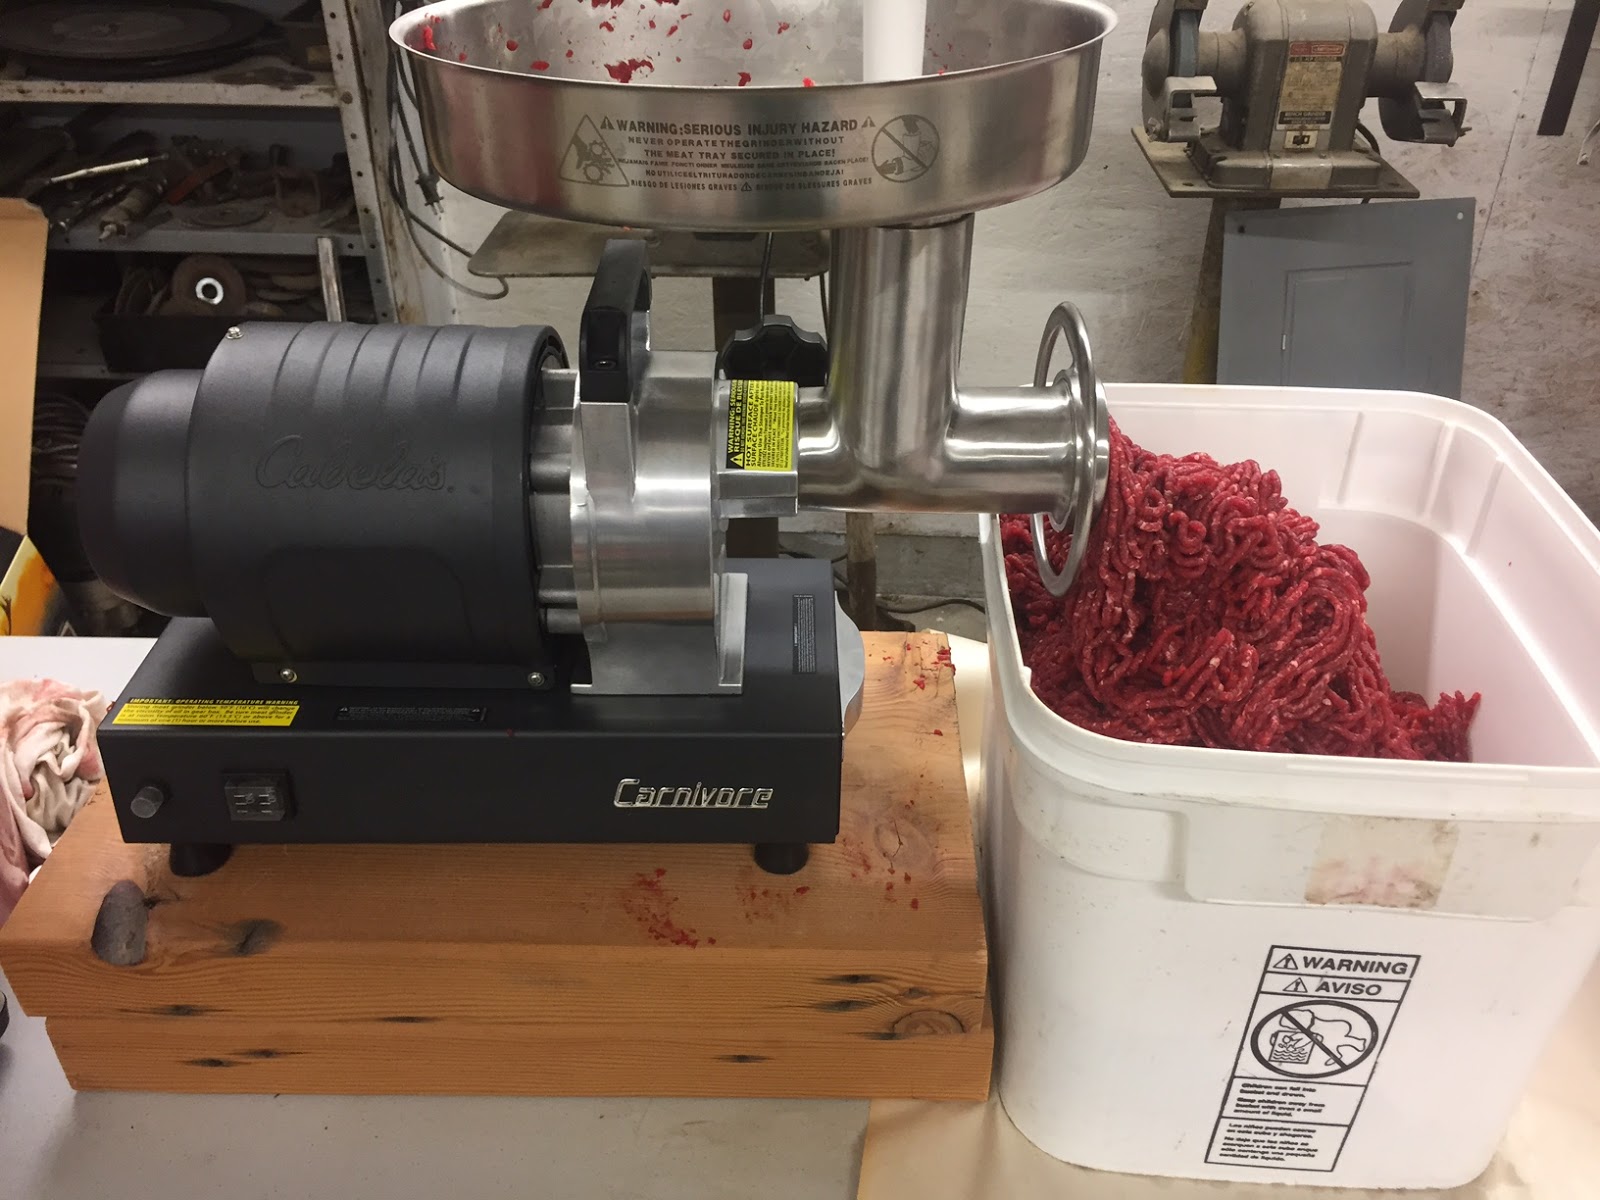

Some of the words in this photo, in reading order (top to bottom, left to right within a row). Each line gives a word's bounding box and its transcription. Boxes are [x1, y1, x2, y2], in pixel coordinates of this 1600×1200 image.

[747, 122, 797, 136] INJURY
[801, 119, 858, 133] HAZARD
[628, 136, 664, 146] NEVER
[644, 149, 666, 158] THE
[666, 150, 694, 159] MEAT
[698, 151, 726, 160] TRAY
[730, 151, 779, 160] SECURED
[783, 151, 795, 159] IN
[798, 149, 836, 158] PLACE!
[631, 179, 657, 188] RIESGO
[659, 181, 668, 189] DE
[671, 181, 706, 191] LESIONES
[708, 182, 737, 191] GRAVES
[843, 177, 872, 187] GRAVES
[735, 401, 742, 413] DE
[746, 401, 754, 443] SURFACE
[734, 415, 742, 453] RISQUE
[613, 778, 774, 809] Carnivore
[1302, 955, 1408, 975] WARNING
[1315, 981, 1382, 996] AVISO
